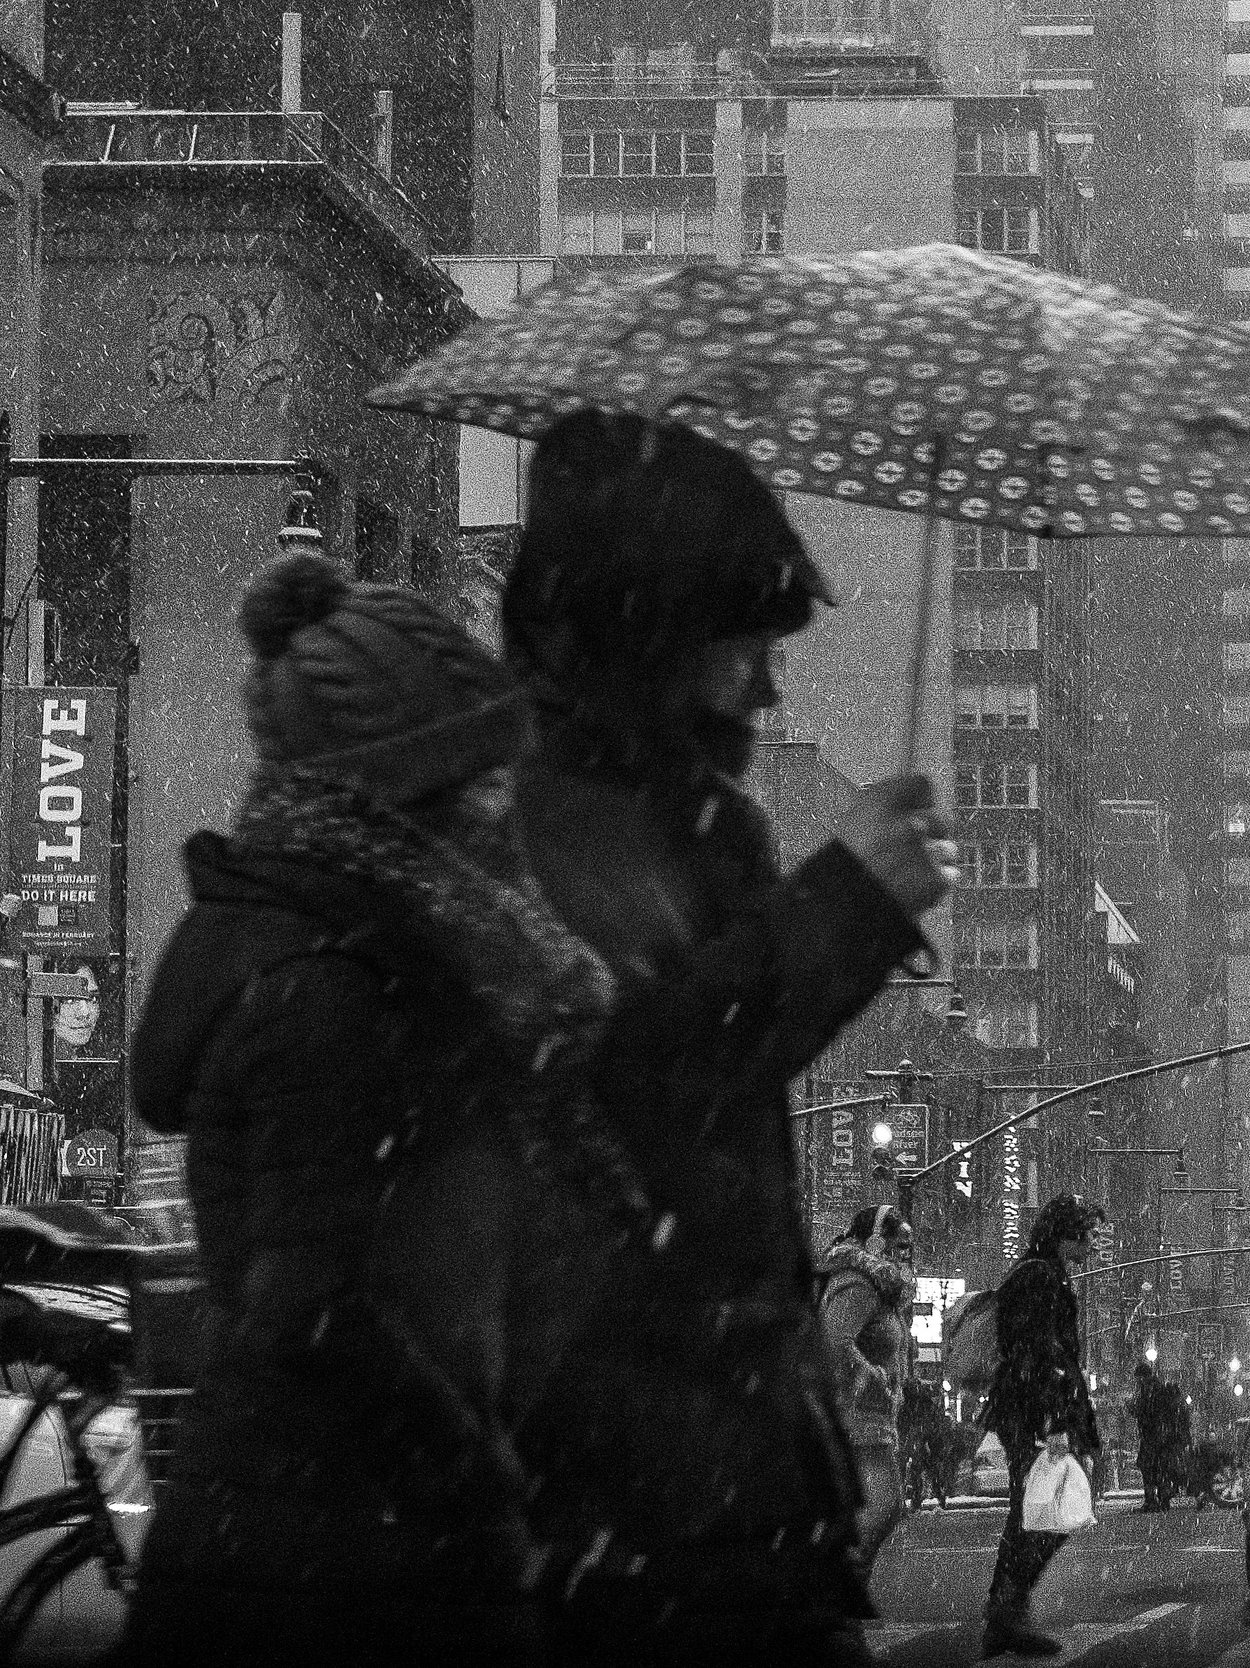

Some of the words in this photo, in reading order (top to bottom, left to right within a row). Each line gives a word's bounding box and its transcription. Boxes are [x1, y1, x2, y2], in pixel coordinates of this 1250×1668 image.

[36, 699, 87, 862] LOVE
[22, 890, 39, 901] DO
[43, 890, 56, 901] IT
[60, 890, 96, 902] HERE
